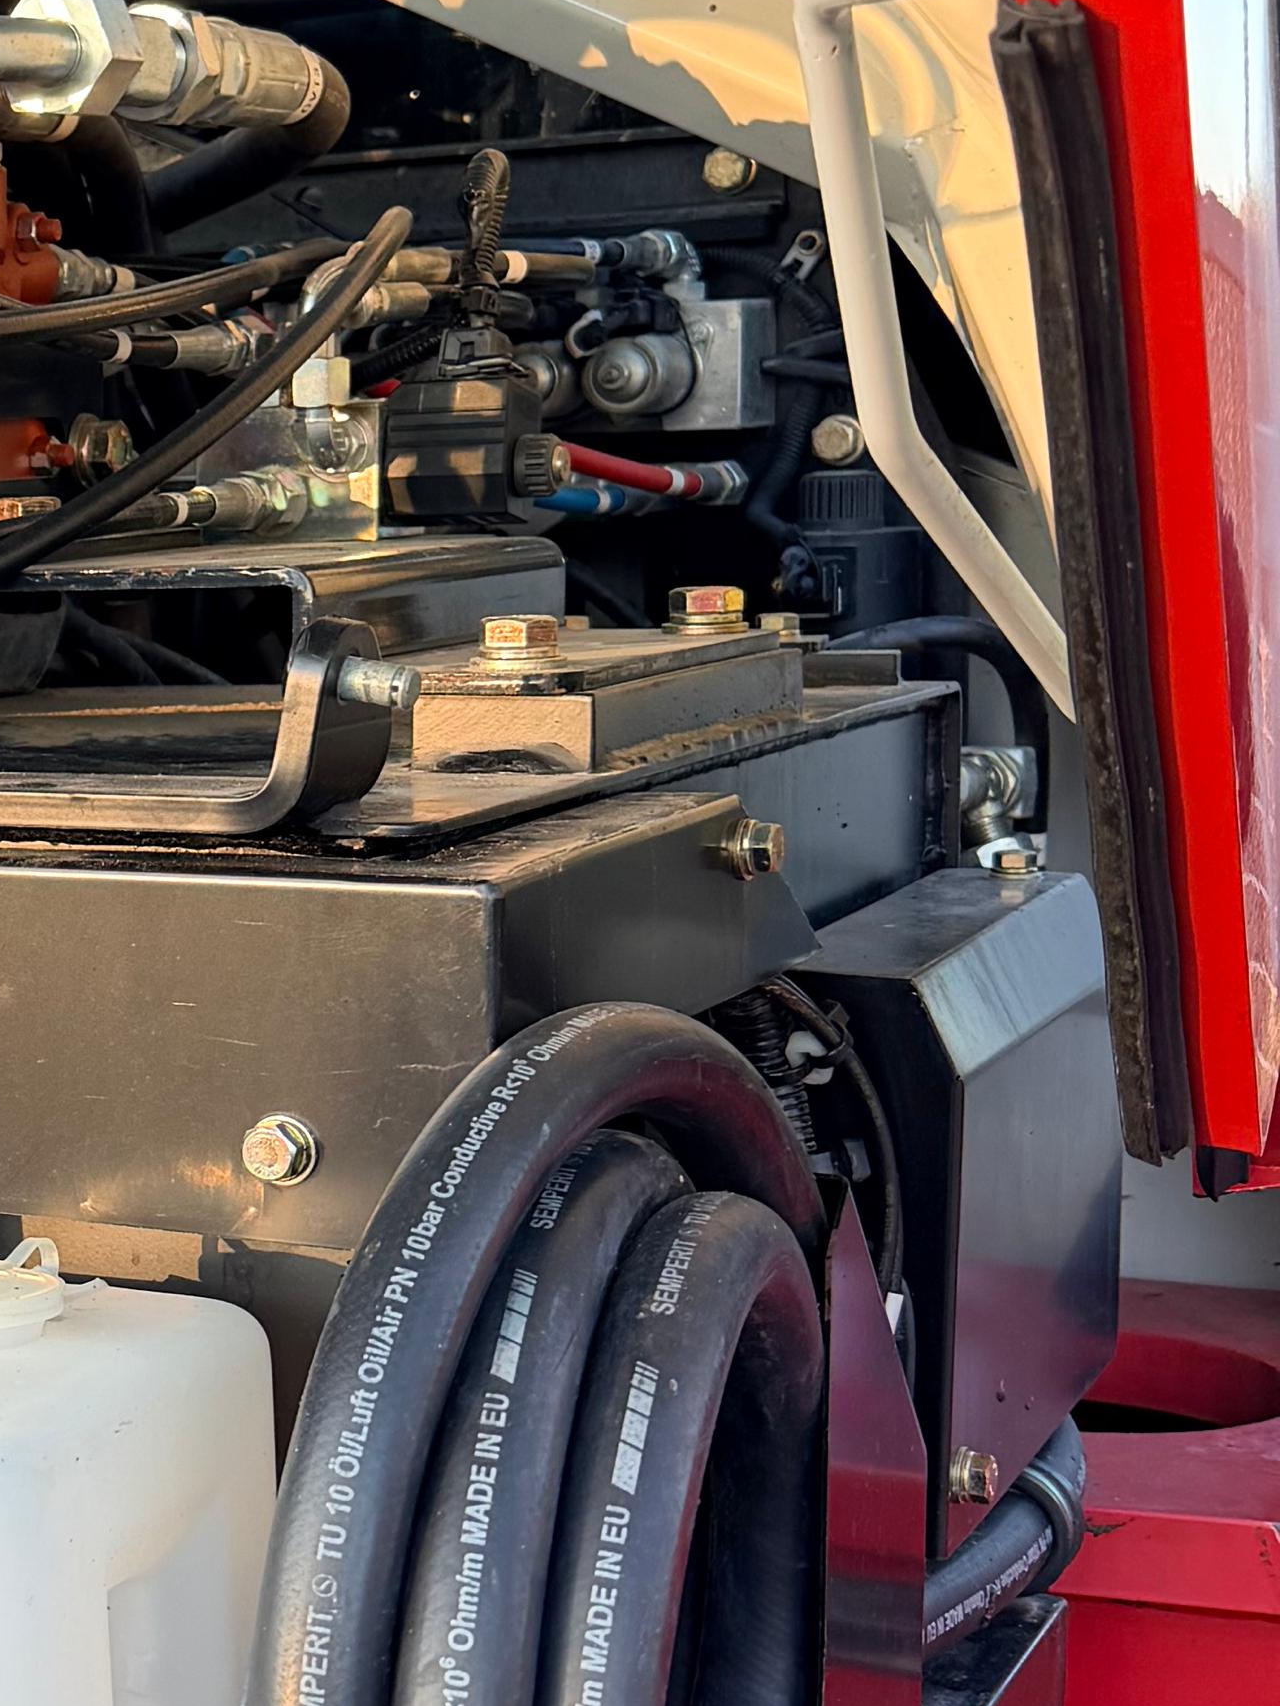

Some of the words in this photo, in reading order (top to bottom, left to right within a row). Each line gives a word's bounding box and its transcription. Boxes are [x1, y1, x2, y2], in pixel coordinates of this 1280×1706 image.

[526, 1020, 581, 1062] Ohm/m
[430, 1099, 507, 1199] Conductive
[530, 1166, 577, 1230] SEMPERIT
[401, 1200, 446, 1260] 10bar
[383, 1266, 419, 1304] PN
[650, 1238, 697, 1315] SEMPERIT
[357, 1305, 403, 1384] Oil/Air
[328, 1388, 378, 1478] Öl/Luft
[480, 1392, 510, 1428] EU
[474, 1432, 503, 1460] IN
[326, 1484, 355, 1514] 10
[460, 1464, 497, 1546] MADE
[600, 1504, 631, 1545] EU
[317, 1523, 347, 1561] TU
[594, 1549, 623, 1581] IN
[448, 1551, 485, 1652] Ohm/m
[580, 1585, 618, 1673] MADE
